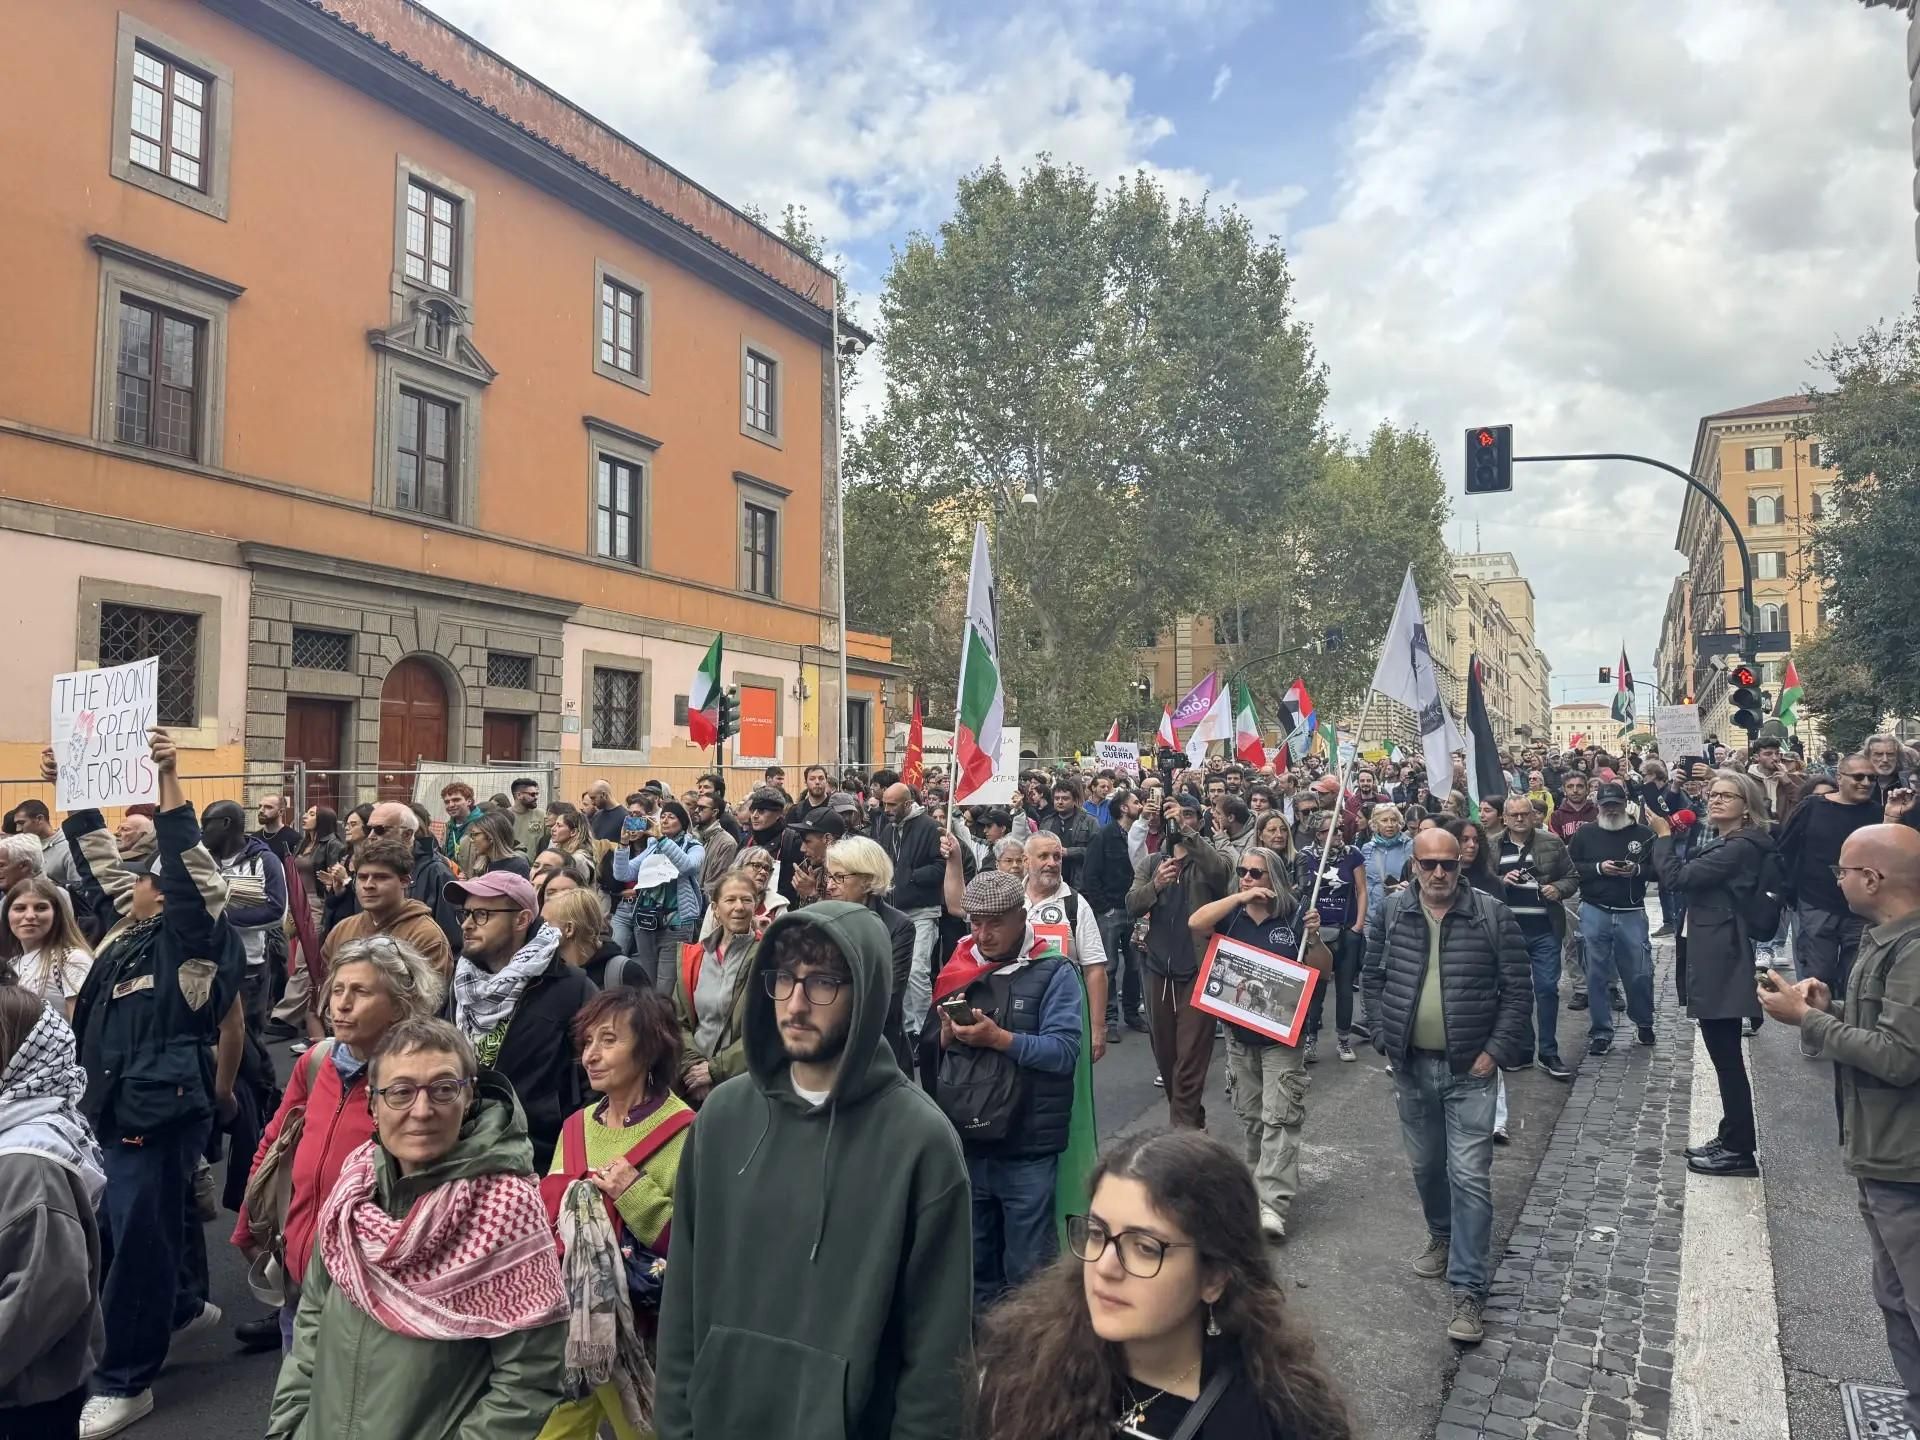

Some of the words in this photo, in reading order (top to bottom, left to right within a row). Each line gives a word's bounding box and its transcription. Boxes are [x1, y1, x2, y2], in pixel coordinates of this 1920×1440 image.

[56, 671, 115, 713] THEY
[113, 660, 157, 706] DON'T
[91, 704, 153, 758] SPEAK
[87, 758, 122, 800] FOR
[125, 754, 153, 795] US
[1102, 752, 1134, 760] GUERRA
[1119, 761, 1137, 770] PACE
